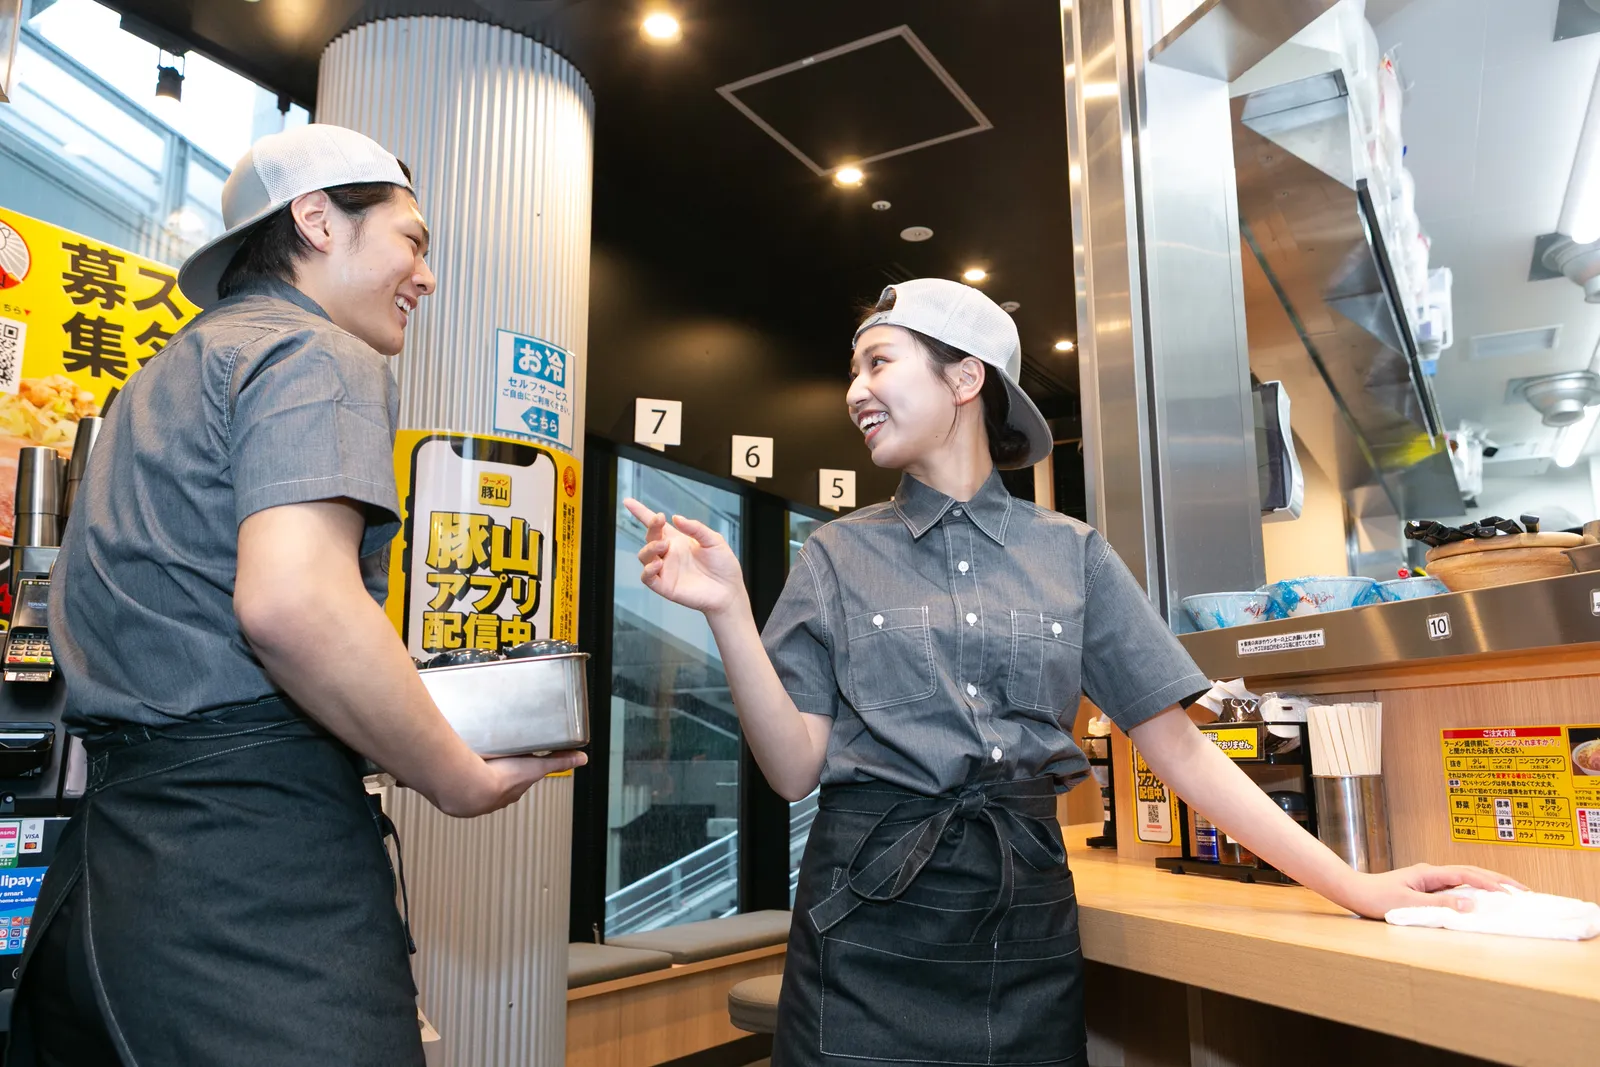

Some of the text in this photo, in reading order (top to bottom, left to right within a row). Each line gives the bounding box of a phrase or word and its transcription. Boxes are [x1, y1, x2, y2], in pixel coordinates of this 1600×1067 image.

[62, 241, 128, 416] 募集
[518, 343, 565, 382] お冷
[508, 376, 568, 403] セルフサービス
[528, 413, 558, 432] こちら
[651, 408, 667, 435] 7
[745, 445, 761, 468] 6
[483, 476, 509, 487] ラーメン
[831, 477, 844, 499] 5
[481, 485, 508, 501] 豚山
[425, 510, 545, 581] 豚山
[426, 572, 541, 620] アプリ
[422, 610, 536, 653] 配信中
[1430, 618, 1447, 635] 10
[1482, 729, 1517, 738] ご注文方法
[1455, 800, 1470, 809] 野菜
[1496, 800, 1510, 808] 標準
[1516, 801, 1529, 809] 野菜
[1498, 818, 1511, 826] 標準
[1535, 820, 1571, 828] アブラマシマシ
[1500, 830, 1513, 838] 標準
[1543, 833, 1565, 841] カラカラ
[0, 874, 34, 889] lipay
